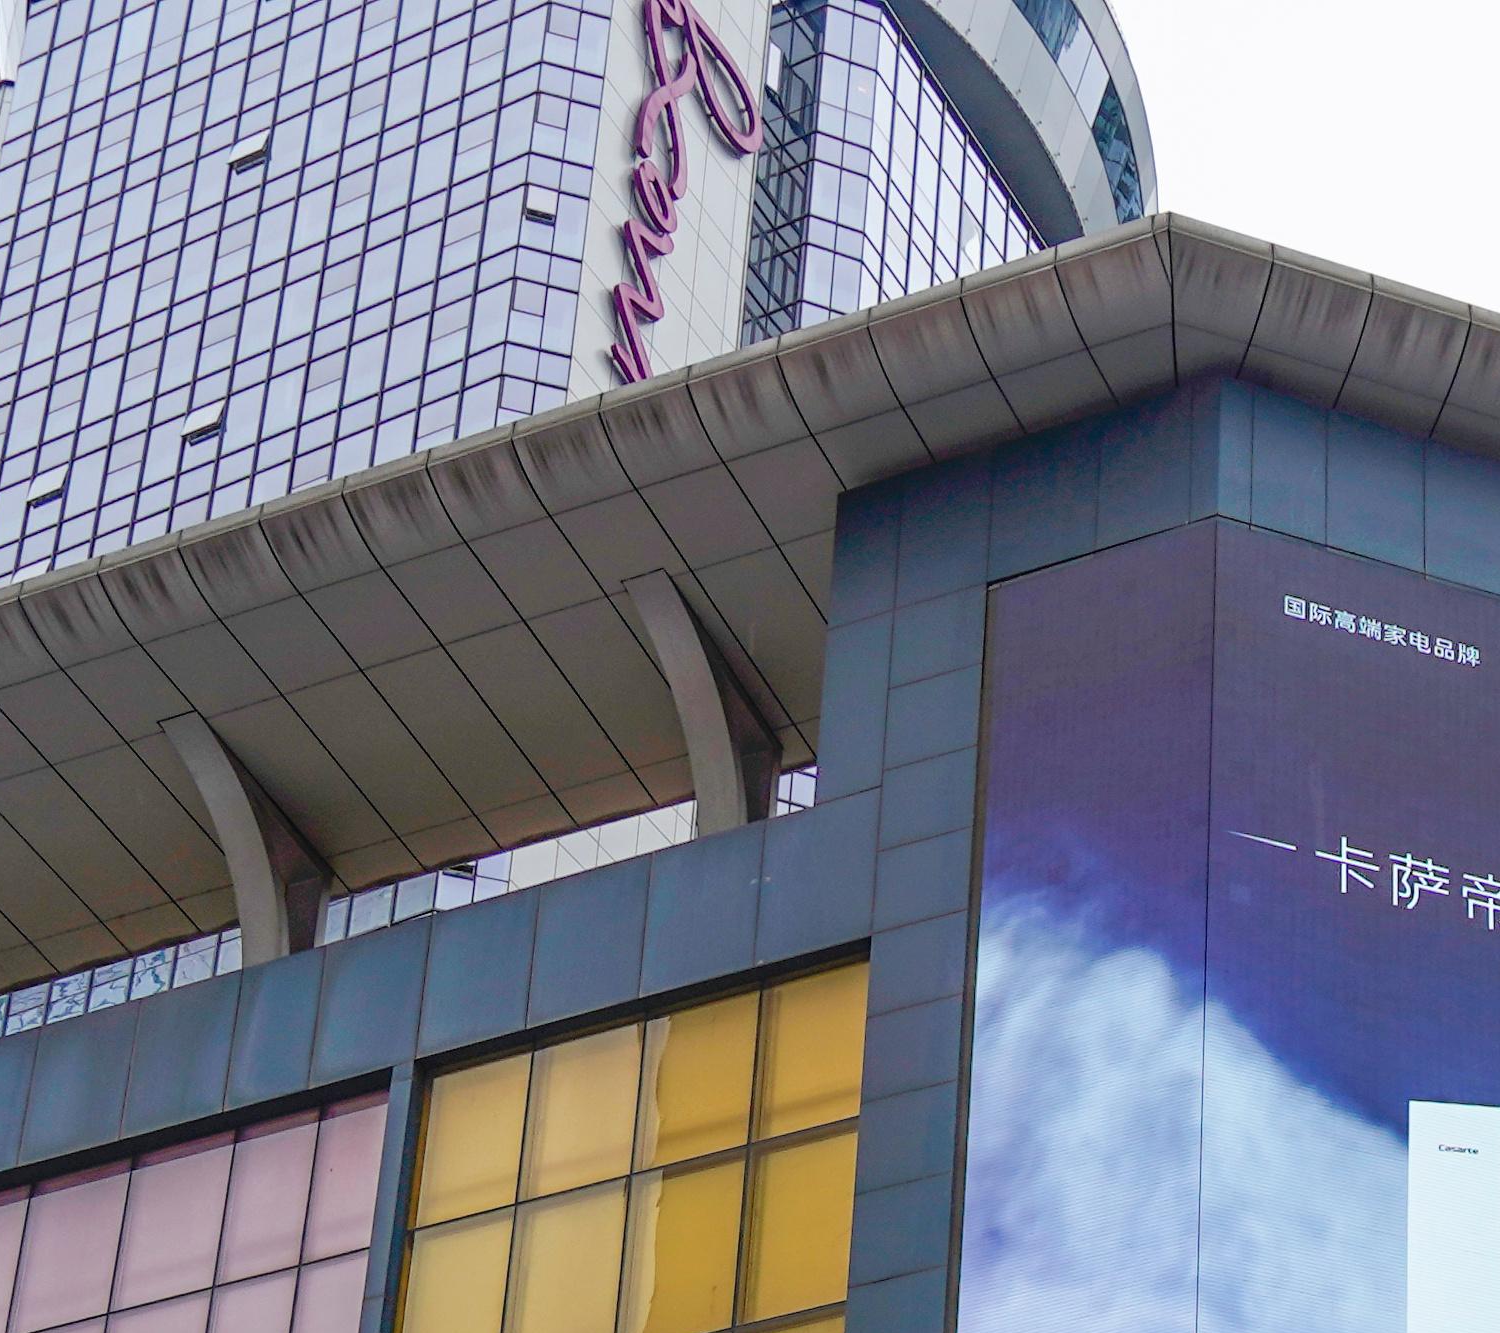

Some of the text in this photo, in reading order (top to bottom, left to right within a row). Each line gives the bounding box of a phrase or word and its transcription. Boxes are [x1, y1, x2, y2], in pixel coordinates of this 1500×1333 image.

[1283, 593, 1482, 669] 国际高端家电品牌
